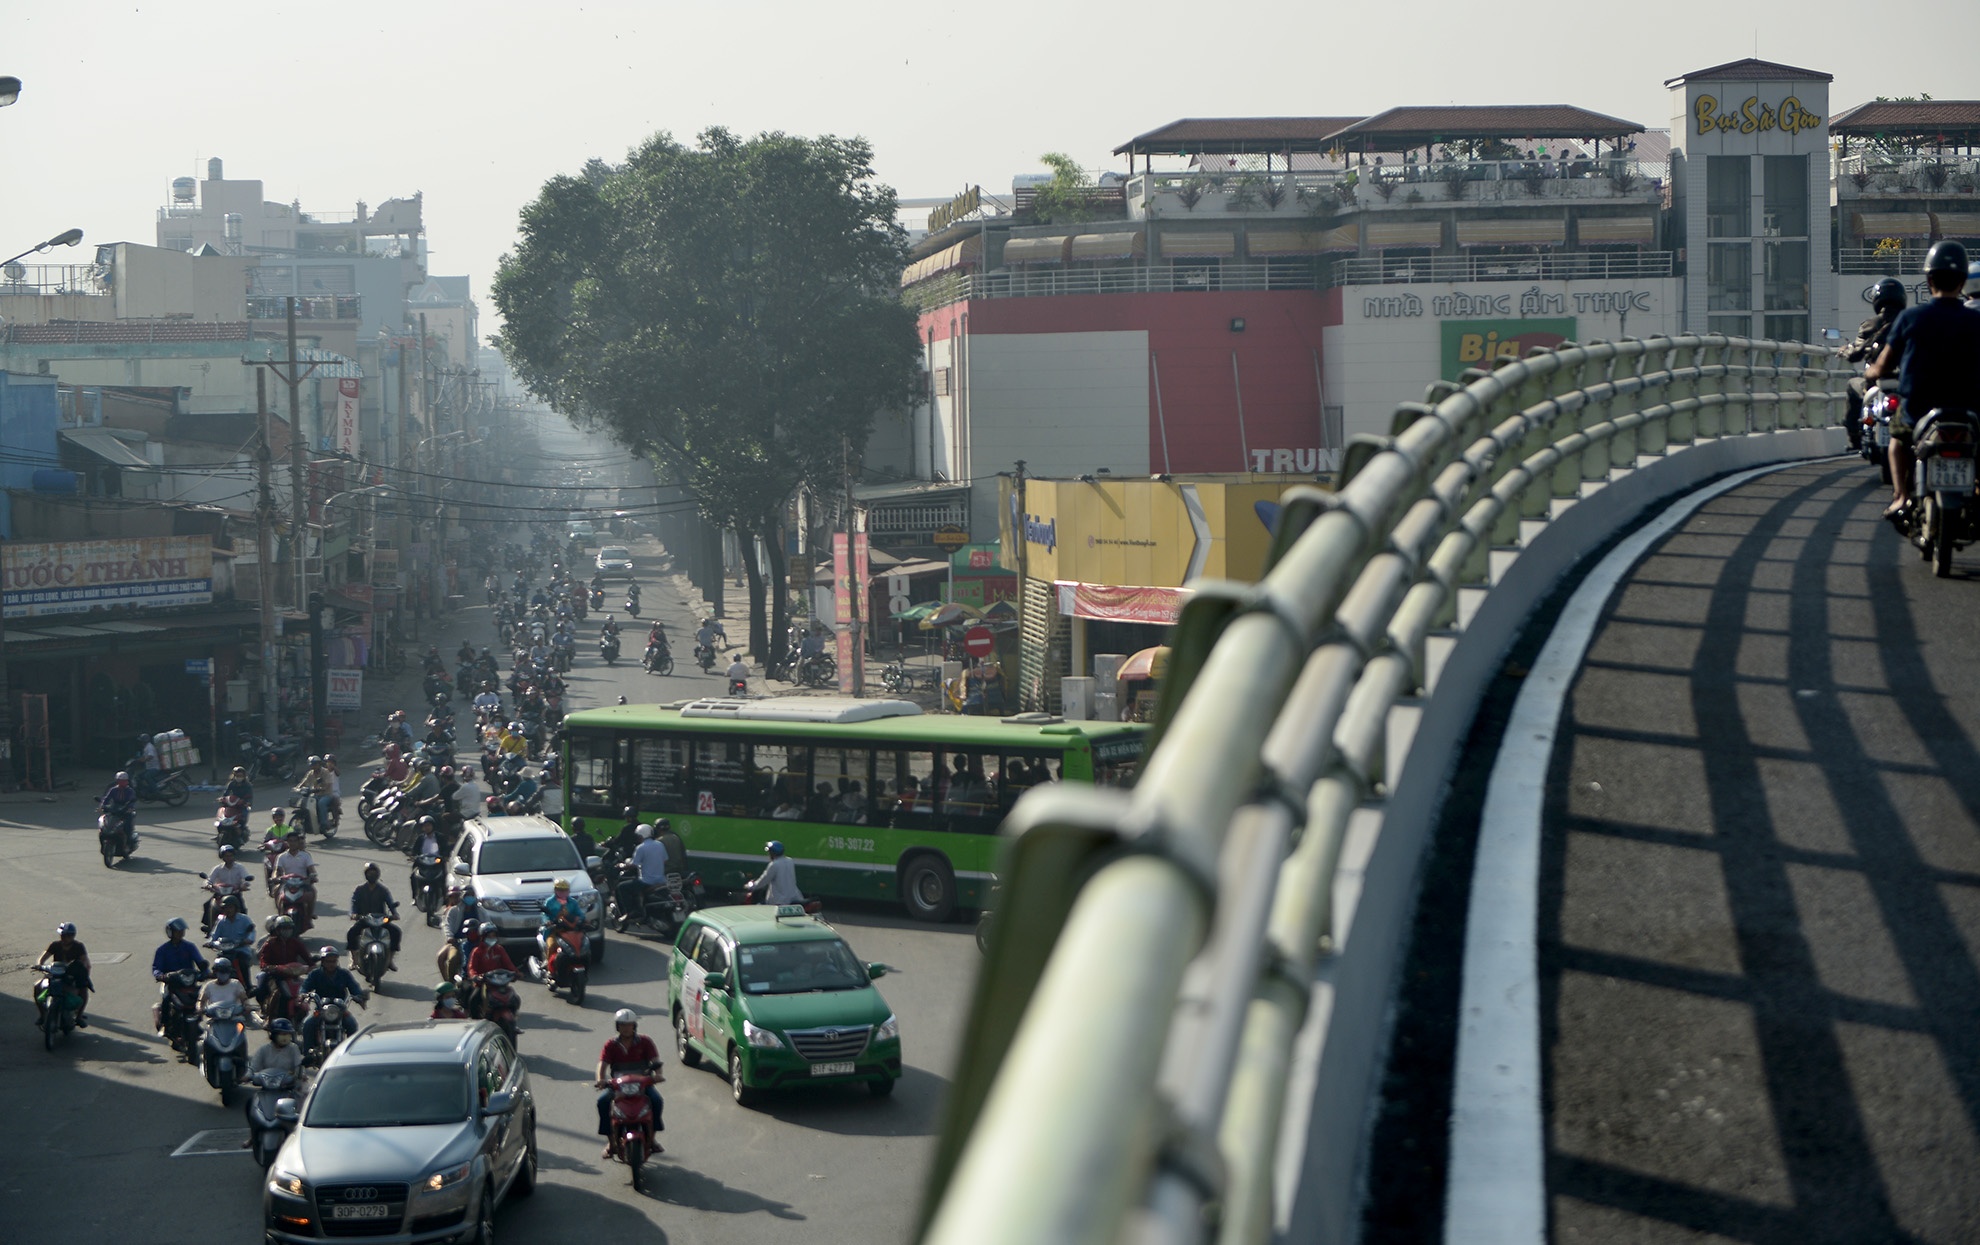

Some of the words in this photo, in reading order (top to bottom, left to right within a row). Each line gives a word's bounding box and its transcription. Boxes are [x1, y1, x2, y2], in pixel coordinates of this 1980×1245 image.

[1695, 94, 1740, 135] Bụi
[1740, 96, 1777, 134] Sài
[1778, 96, 1822, 135] Gòn
[1363, 292, 1424, 317] NHÀ
[1432, 291, 1511, 316] HÀNG
[1520, 286, 1565, 315] ẨM
[1573, 290, 1651, 315] THỰC
[85, 553, 187, 582] THÀNH
[331, 677, 359, 692] TNT
[699, 793, 713, 811] 24
